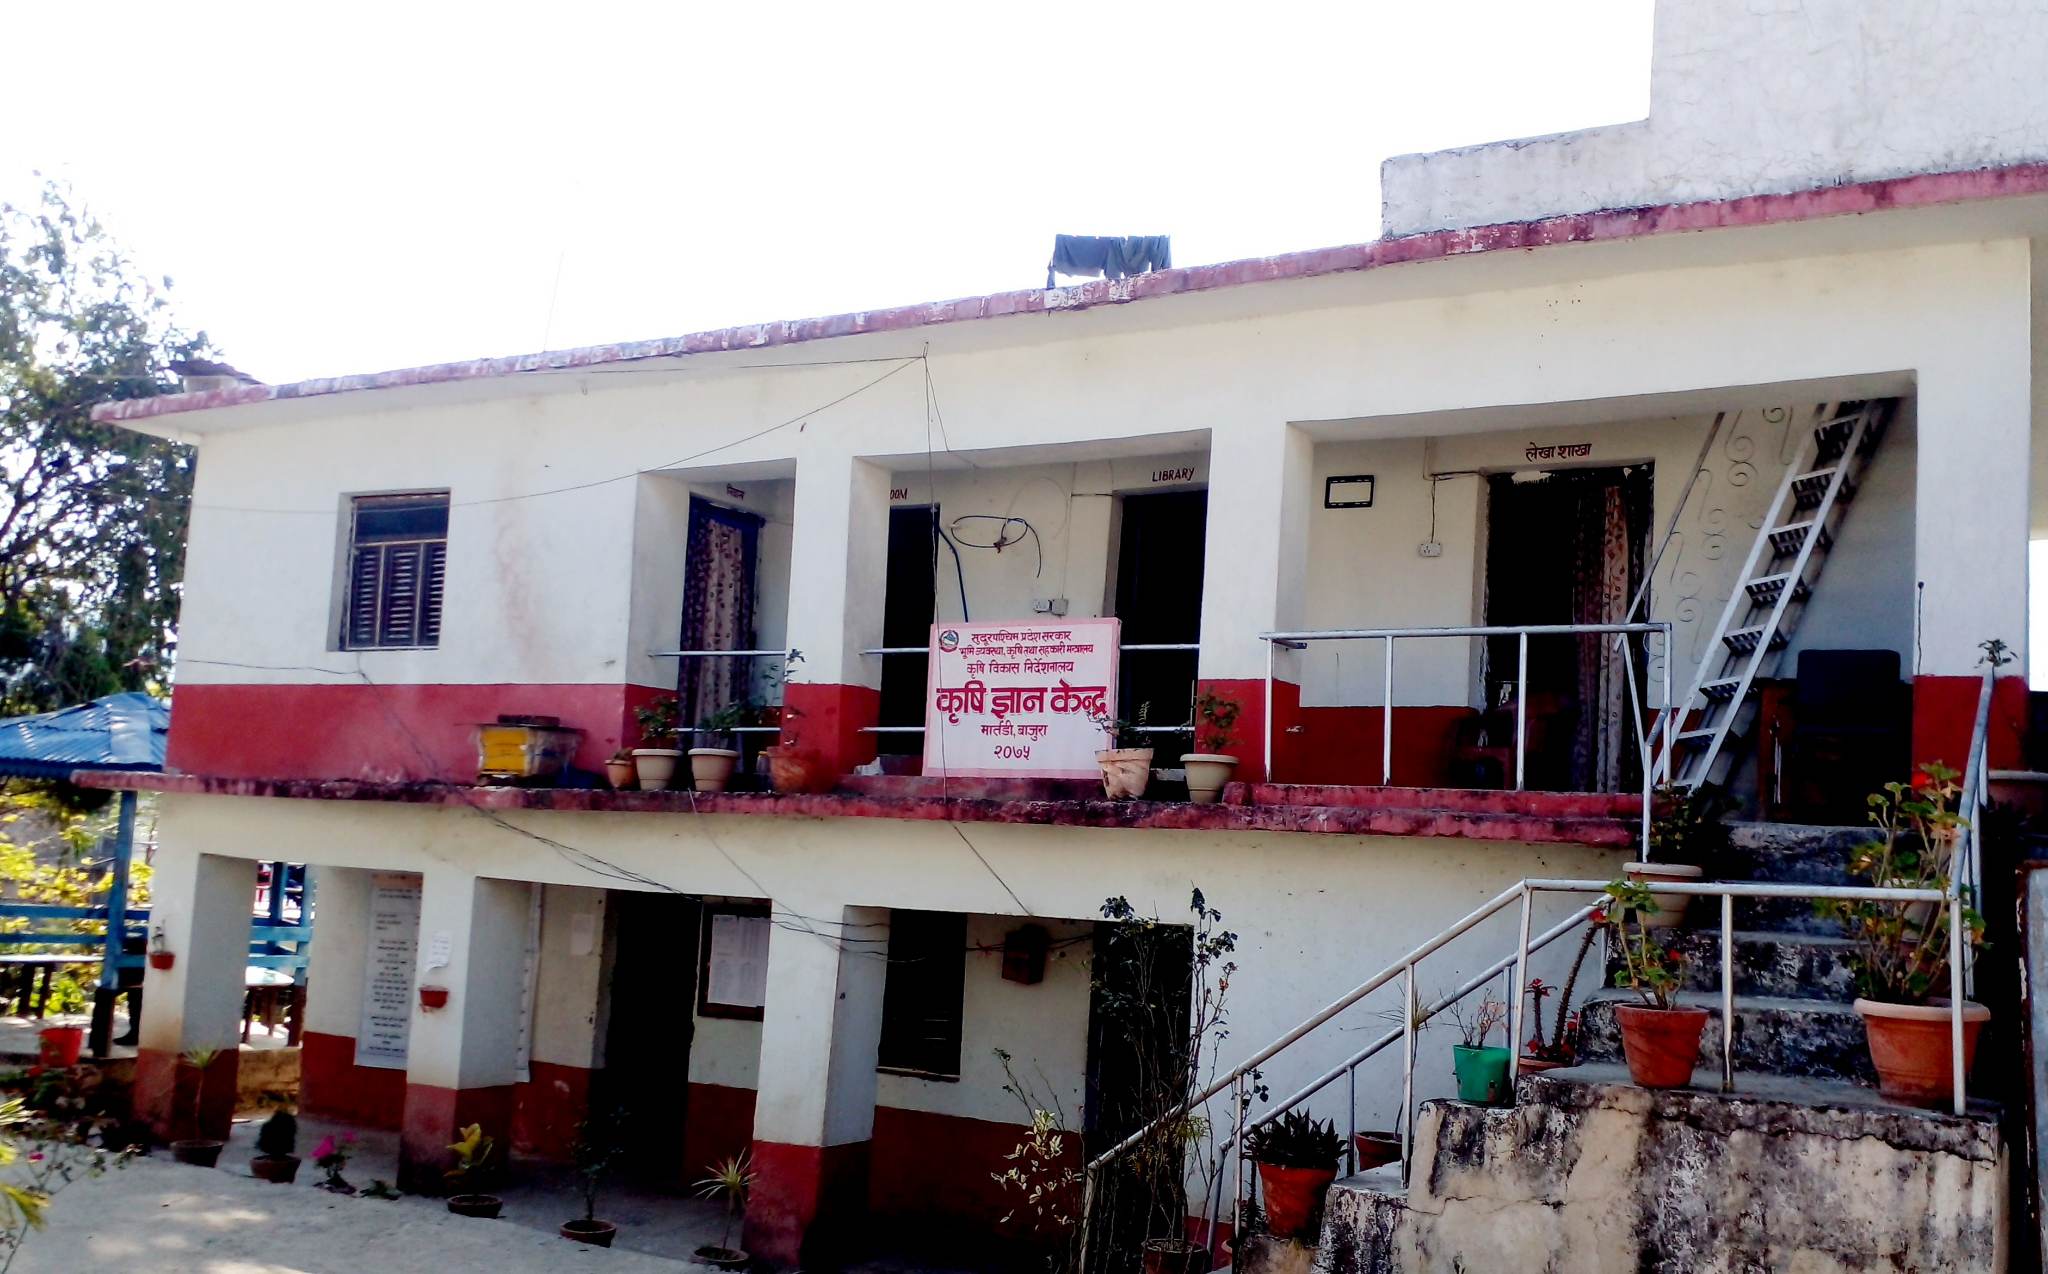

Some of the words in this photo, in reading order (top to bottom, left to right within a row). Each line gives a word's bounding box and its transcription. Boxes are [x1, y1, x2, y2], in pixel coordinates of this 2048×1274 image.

[1525, 442, 1555, 462] लेखा
[1557, 443, 1592, 459] शाखा
[1152, 467, 1195, 482] LIBRARY
[1021, 629, 1041, 642] प्रदेश
[1042, 631, 1072, 642] सरकार
[959, 645, 974, 659] भूमि
[1007, 643, 1023, 659] कृषि
[1024, 645, 1038, 655] तथा
[1038, 641, 1066, 657] सहकारी
[967, 660, 985, 679] कृषि
[989, 659, 1020, 674] विकास
[1024, 658, 1074, 675] निर्देशनालय
[936, 679, 987, 724] कृषि
[991, 687, 1048, 719] ज्ञान
[1050, 678, 1107, 716] केन्द्र
[1017, 725, 1048, 741] बाजुरा
[994, 745, 1030, 760] २०७५
